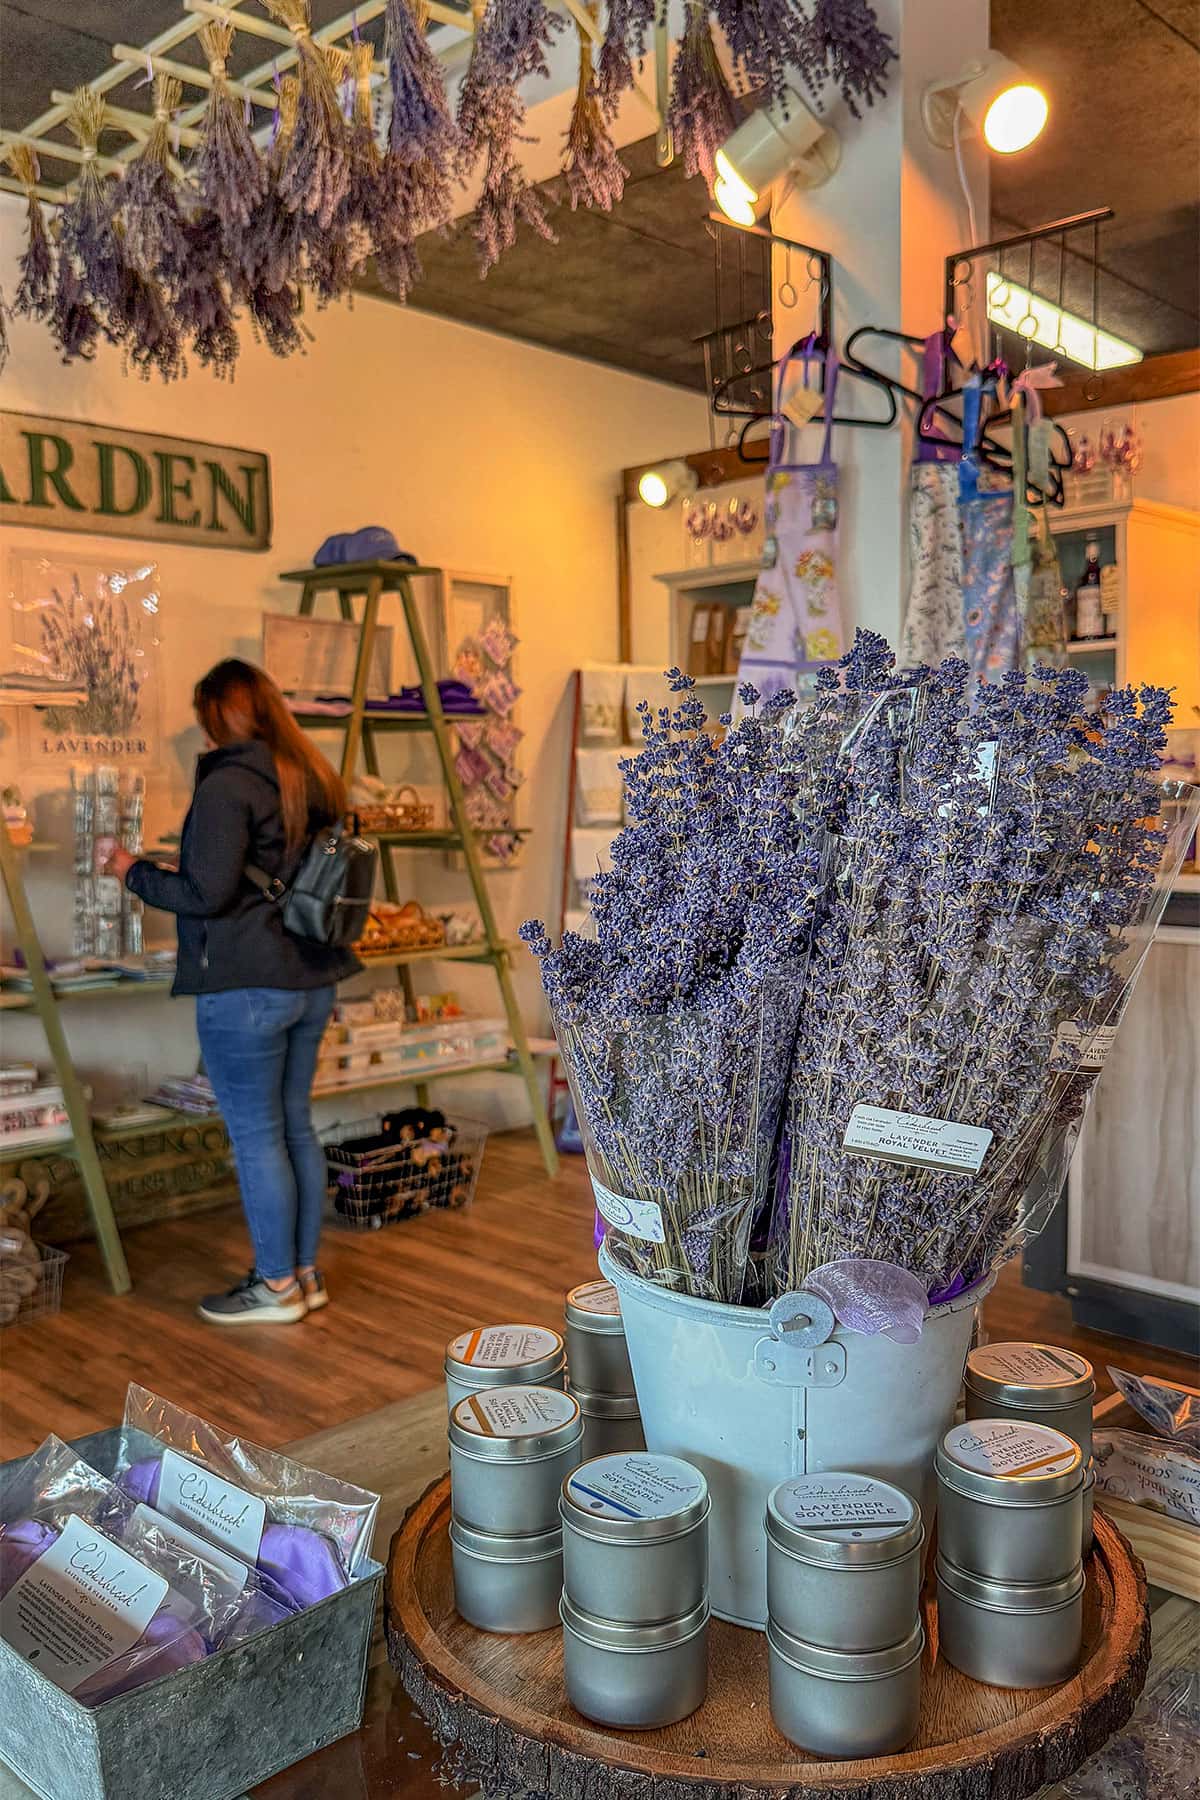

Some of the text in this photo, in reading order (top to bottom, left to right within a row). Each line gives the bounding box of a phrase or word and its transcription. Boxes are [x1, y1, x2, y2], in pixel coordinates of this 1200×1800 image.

[41, 739, 147, 754] LAVENDER
[878, 1137, 909, 1149] ROYAL
[912, 1143, 946, 1156] VELVET
[889, 1132, 939, 1147] LAVENDER
[494, 1408, 511, 1429] CANDLE
[501, 1401, 516, 1423] VANILLA
[507, 1398, 527, 1425] LAVENDER
[983, 1439, 1035, 1459] LAVENDER
[992, 1458, 1013, 1468] SOY
[1014, 1445, 1056, 1461] CANDLE
[999, 1446, 1033, 1459] LEMON
[601, 1472, 622, 1485] SOY
[622, 1482, 663, 1505] CANDLE
[787, 1483, 875, 1498] Cedarbrook
[178, 1472, 250, 1528] Cedarbrook
[800, 1501, 885, 1512] LAVENDER
[795, 1507, 897, 1519] SOY CANDLE
